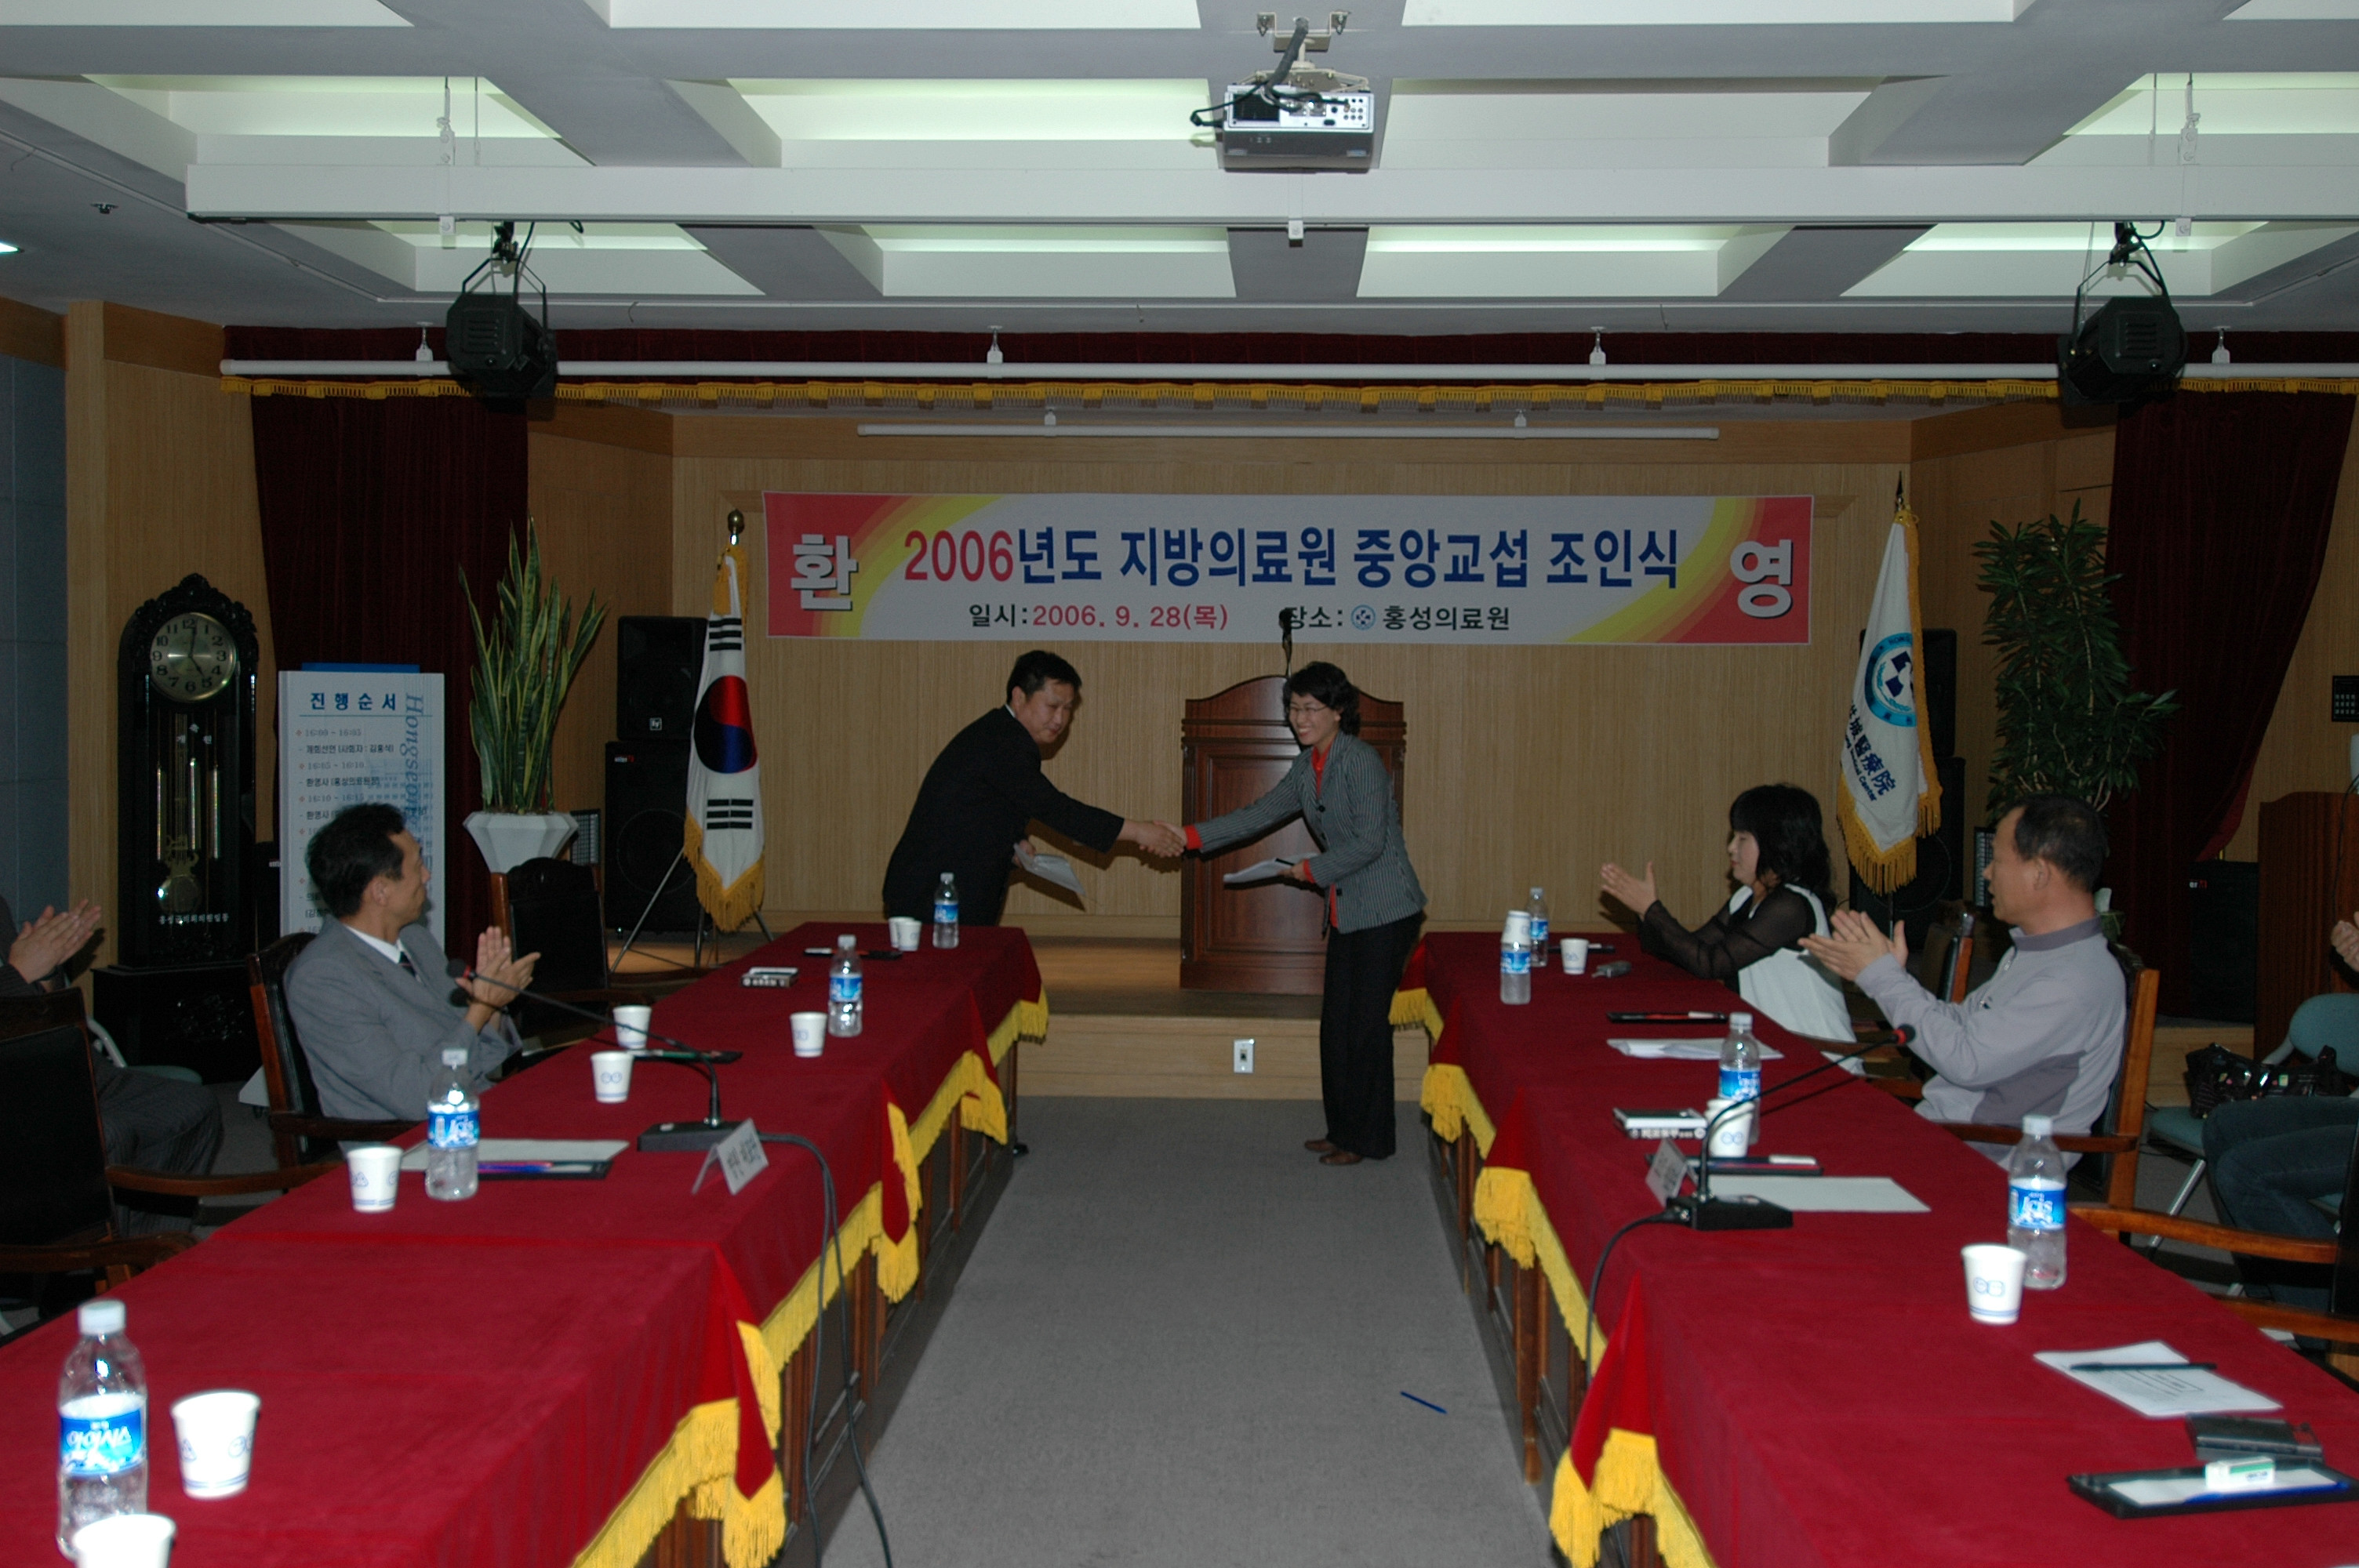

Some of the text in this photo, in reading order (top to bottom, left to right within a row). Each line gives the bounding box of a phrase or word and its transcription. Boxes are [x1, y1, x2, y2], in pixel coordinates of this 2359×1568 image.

[903, 526, 1678, 589] 2006년도 지방의료원 중앙교섭 조인식
[790, 533, 858, 611] 환
[1729, 539, 1794, 619] 영
[1150, 604, 1229, 630] 28(목)
[1382, 605, 1510, 630] 홍성의료원
[213, 636, 224, 647] 2
[216, 650, 227, 662] 3
[212, 666, 221, 676] 4
